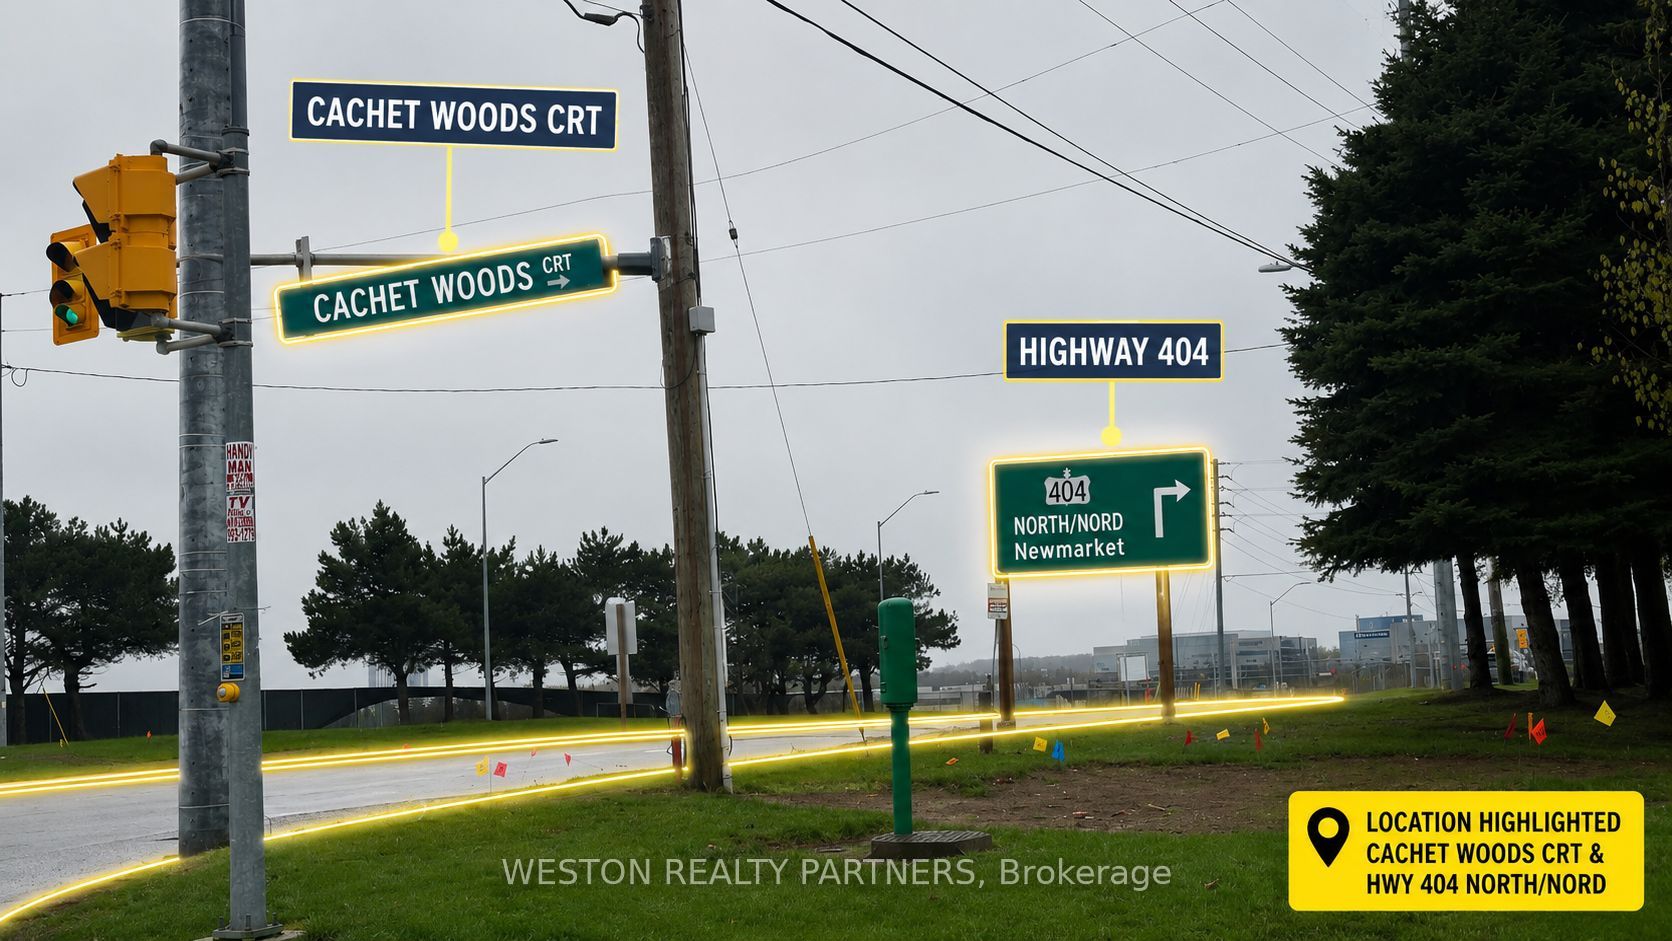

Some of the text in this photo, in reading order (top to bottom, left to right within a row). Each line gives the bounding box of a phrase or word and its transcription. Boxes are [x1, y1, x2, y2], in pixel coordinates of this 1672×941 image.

[313, 253, 572, 324] CACHET WOODS CRT
[226, 443, 253, 459] HANDY
[227, 460, 252, 474] MAN
[229, 496, 251, 509] TV
[1048, 479, 1087, 503] 404
[1014, 512, 1123, 535] NORTH/NORD
[1015, 537, 1125, 560] Newmarket
